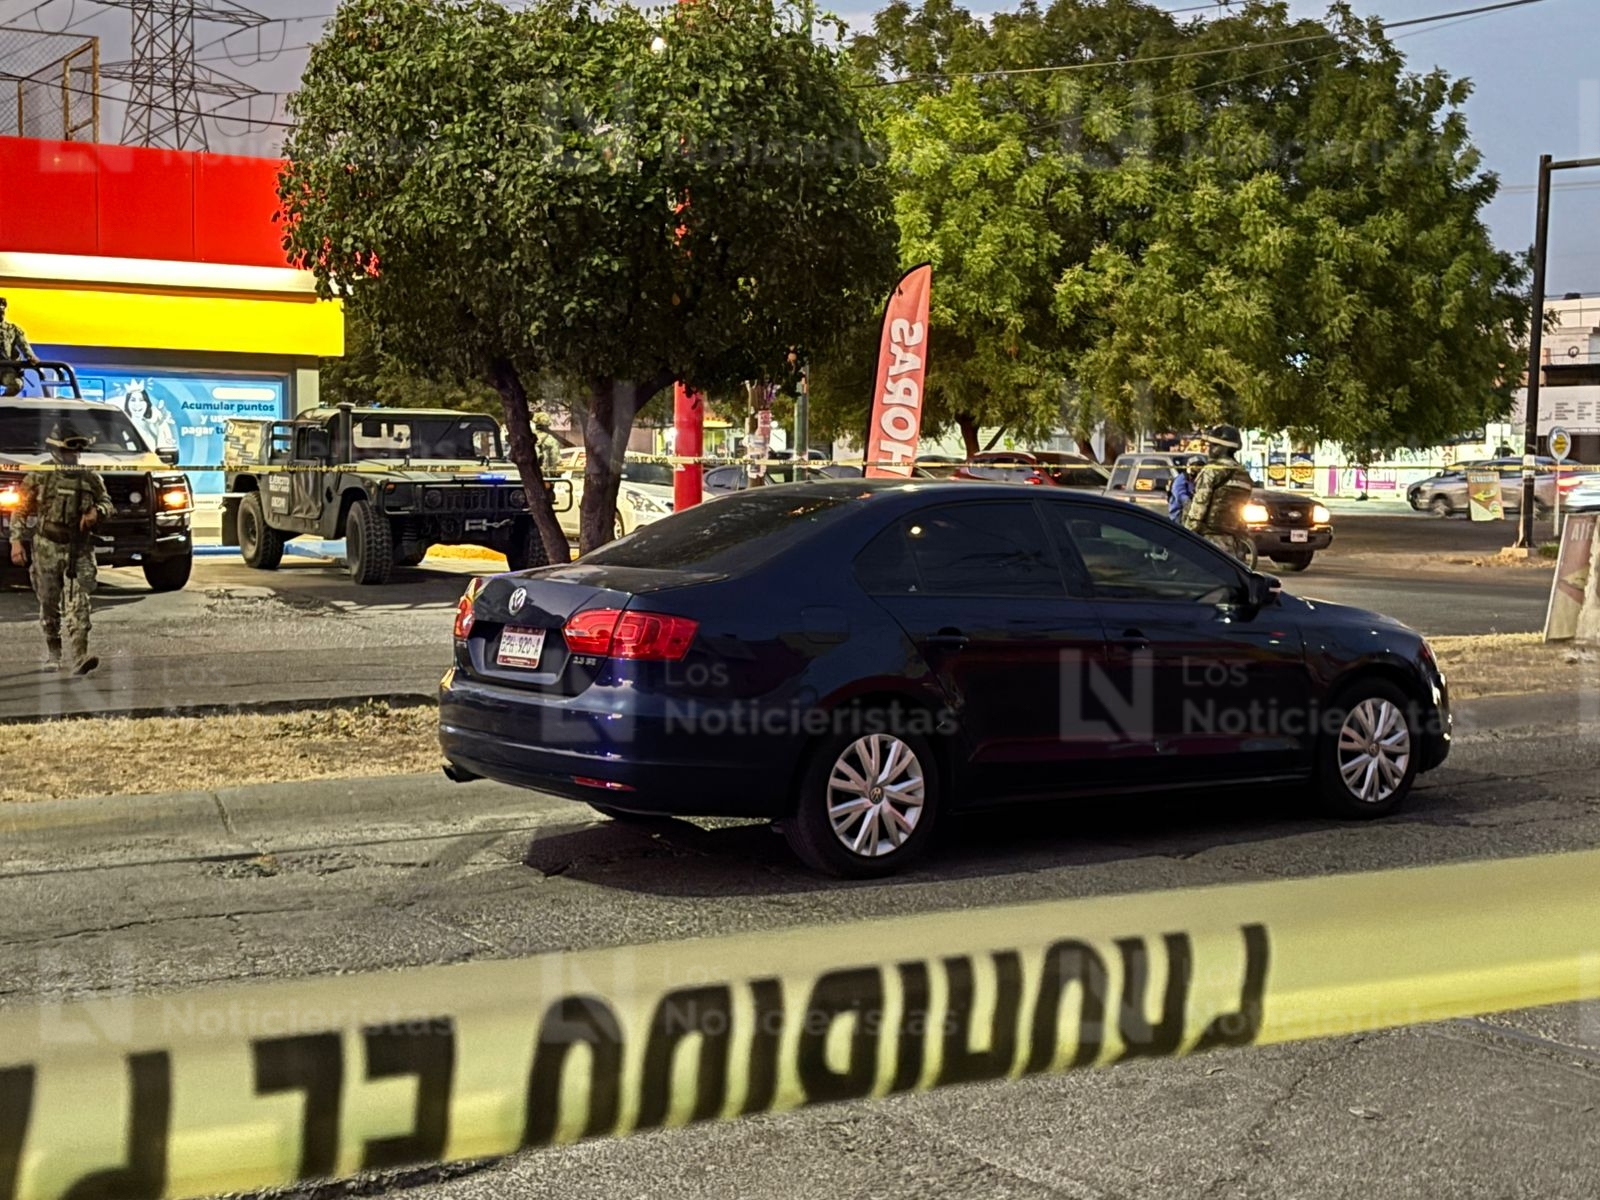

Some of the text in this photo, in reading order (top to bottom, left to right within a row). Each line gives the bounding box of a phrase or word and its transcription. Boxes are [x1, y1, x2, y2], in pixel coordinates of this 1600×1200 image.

[181, 401, 275, 413] Acumular puntos
[200, 415, 208, 425] y
[181, 426, 214, 436] pagar
